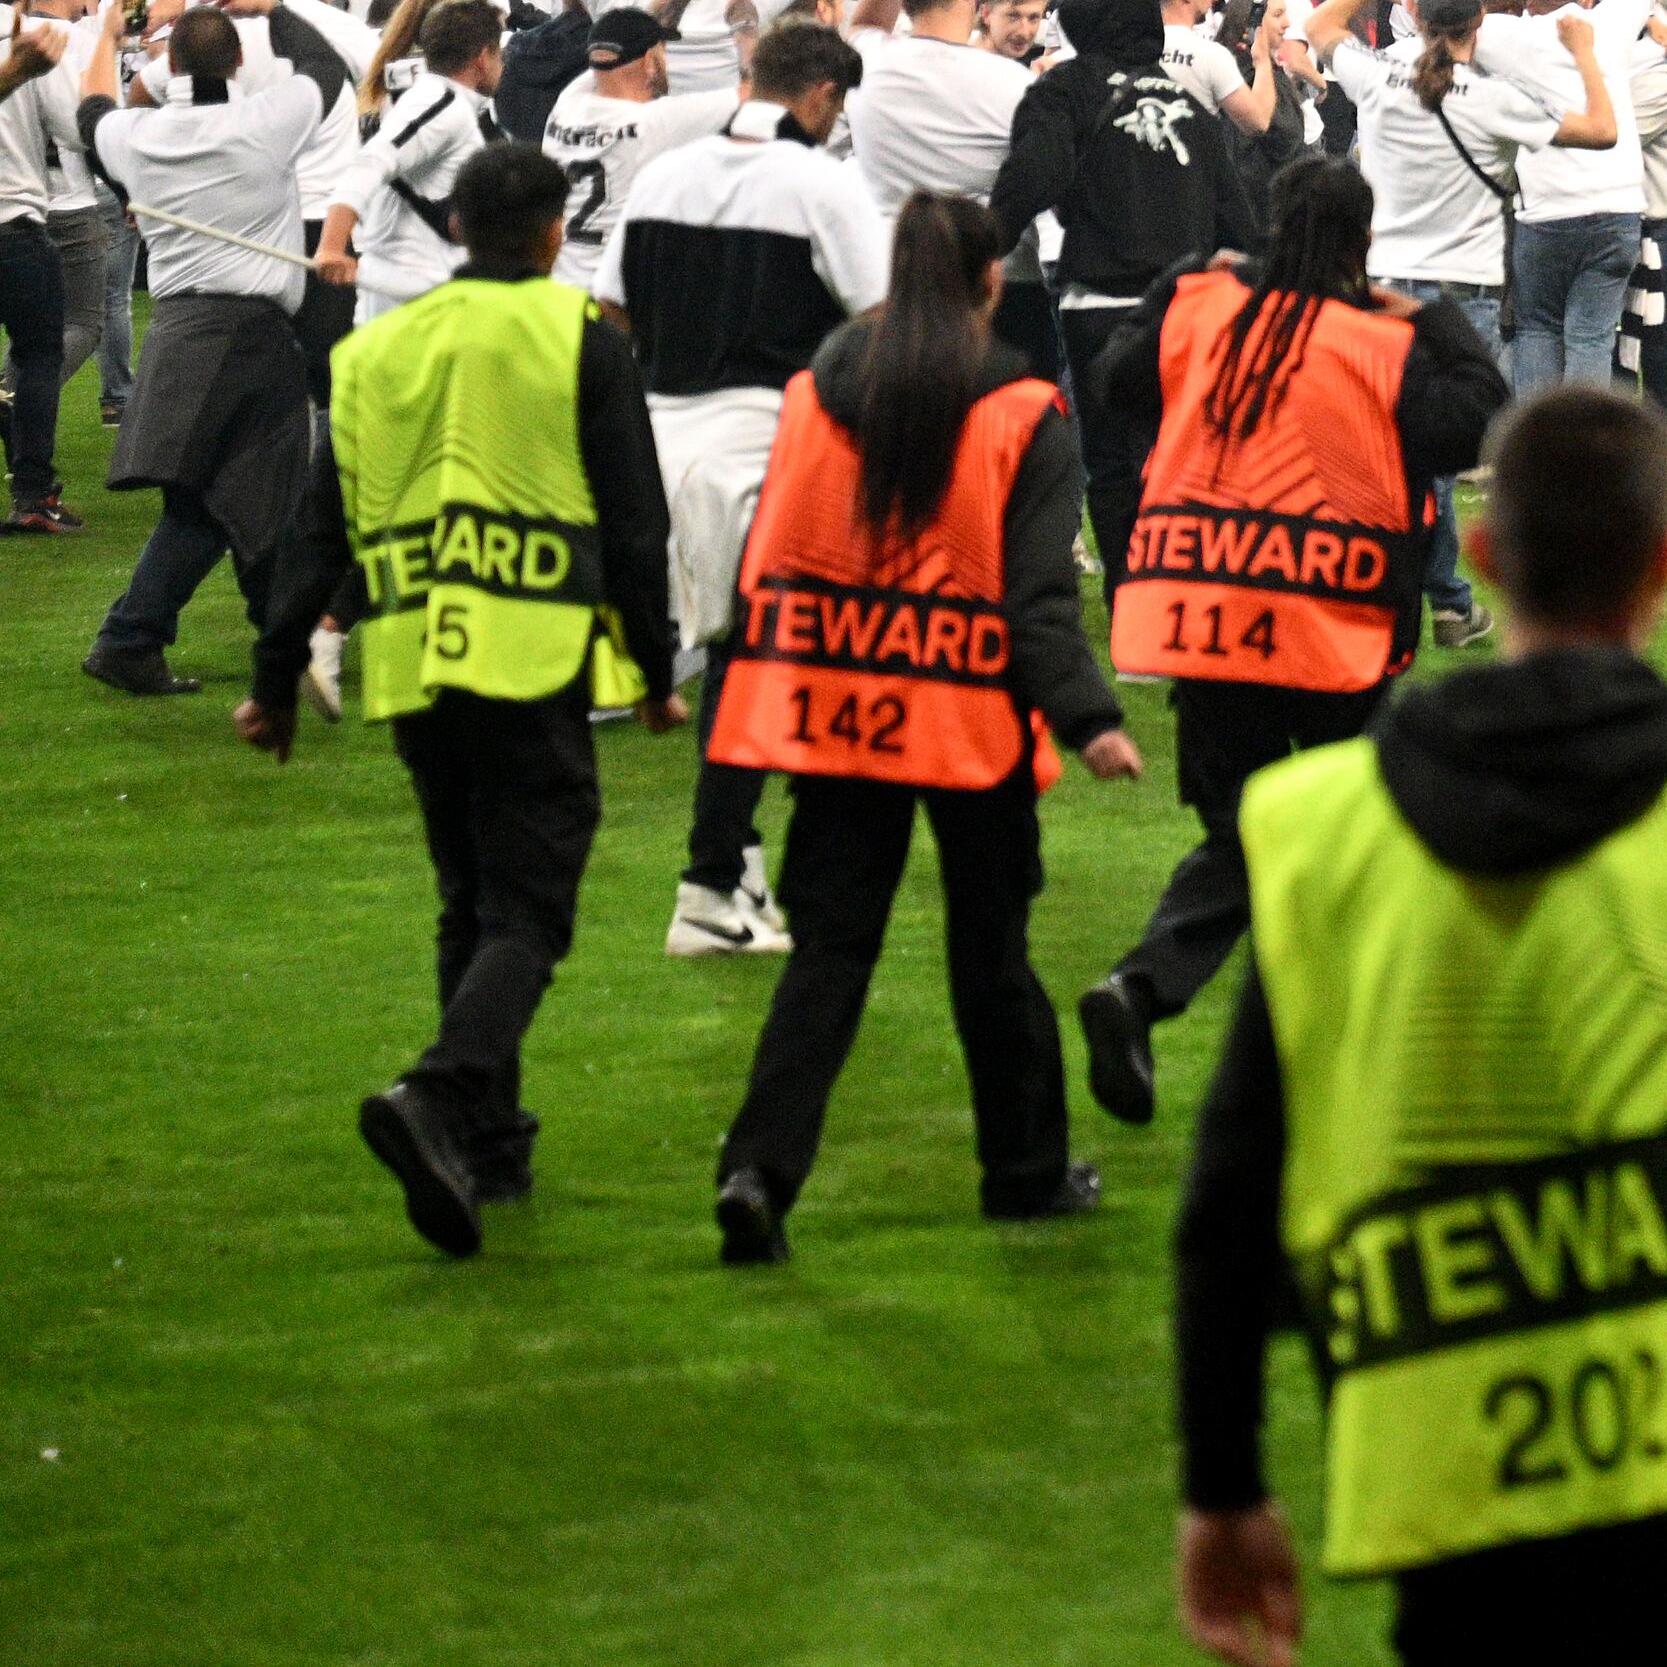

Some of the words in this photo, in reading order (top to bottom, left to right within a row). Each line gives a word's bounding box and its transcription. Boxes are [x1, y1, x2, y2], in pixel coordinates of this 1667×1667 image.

[1127, 514, 1387, 593] STEWARD
[1161, 602, 1278, 661] 114
[785, 687, 908, 753] 142
